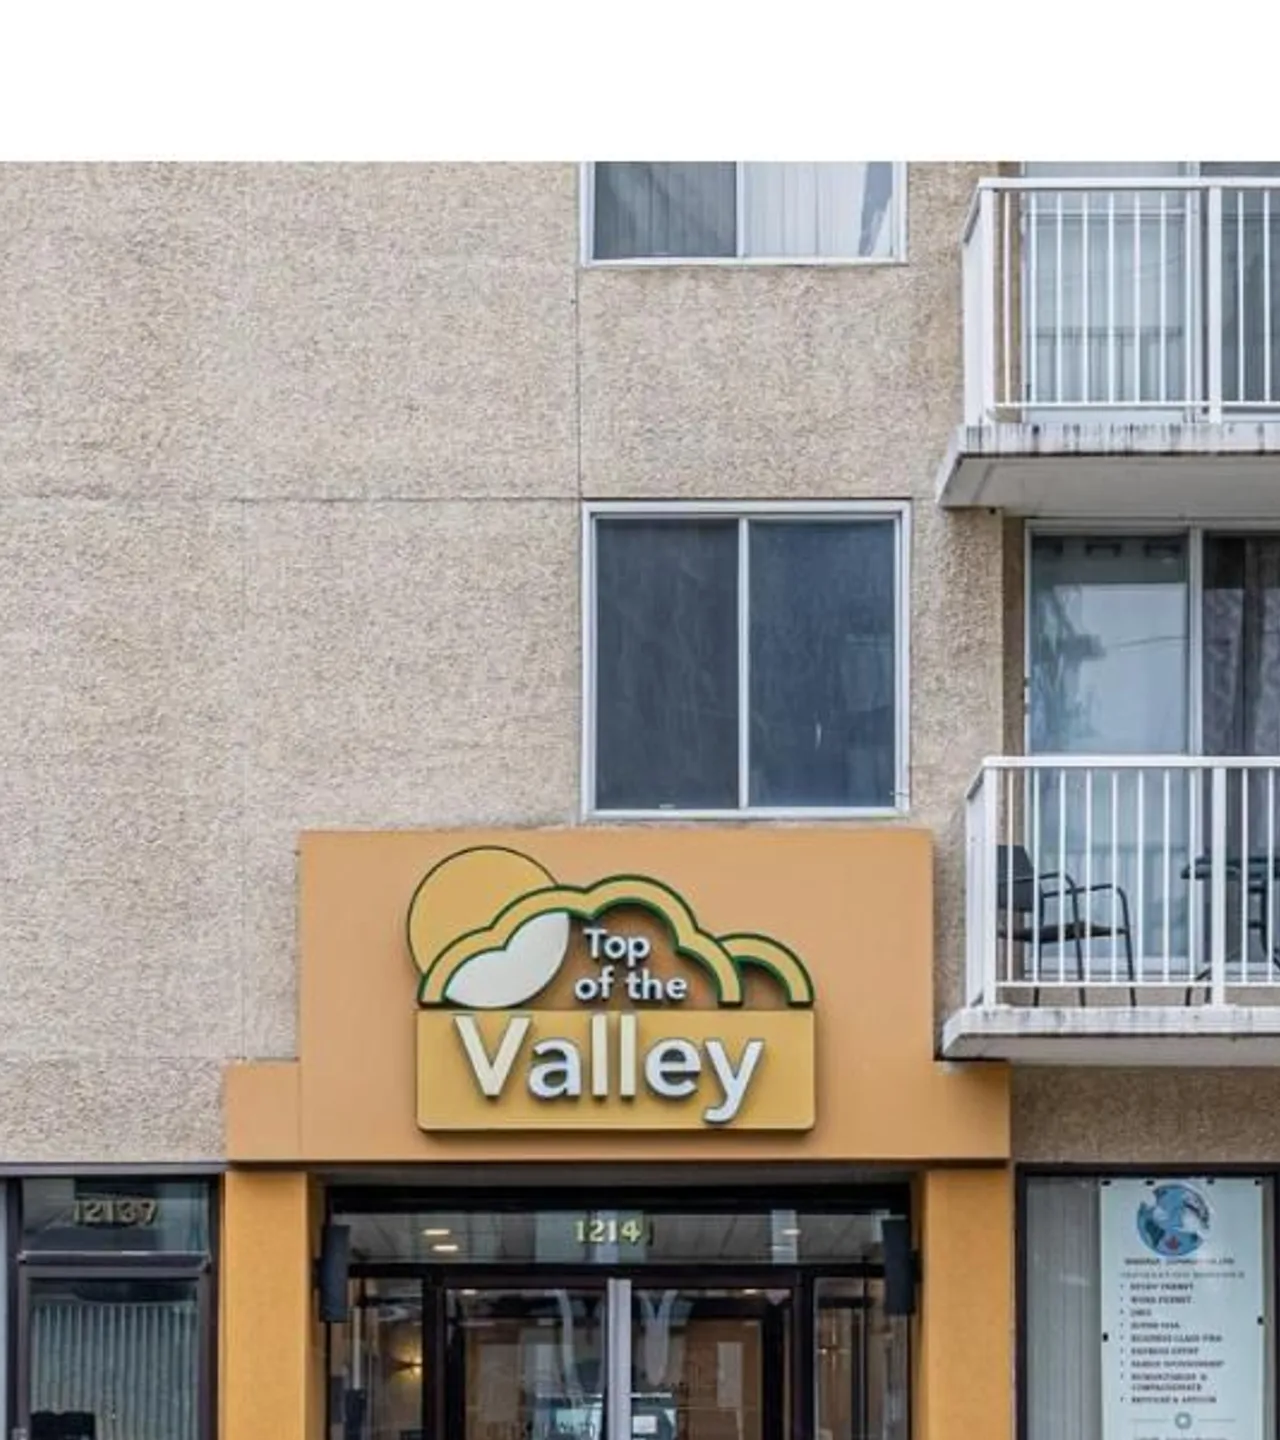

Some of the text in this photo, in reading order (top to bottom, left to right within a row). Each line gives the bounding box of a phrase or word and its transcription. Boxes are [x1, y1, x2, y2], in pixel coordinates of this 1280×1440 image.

[583, 927, 652, 965] Top
[575, 965, 688, 1001] of the
[452, 1012, 766, 1124] Valley
